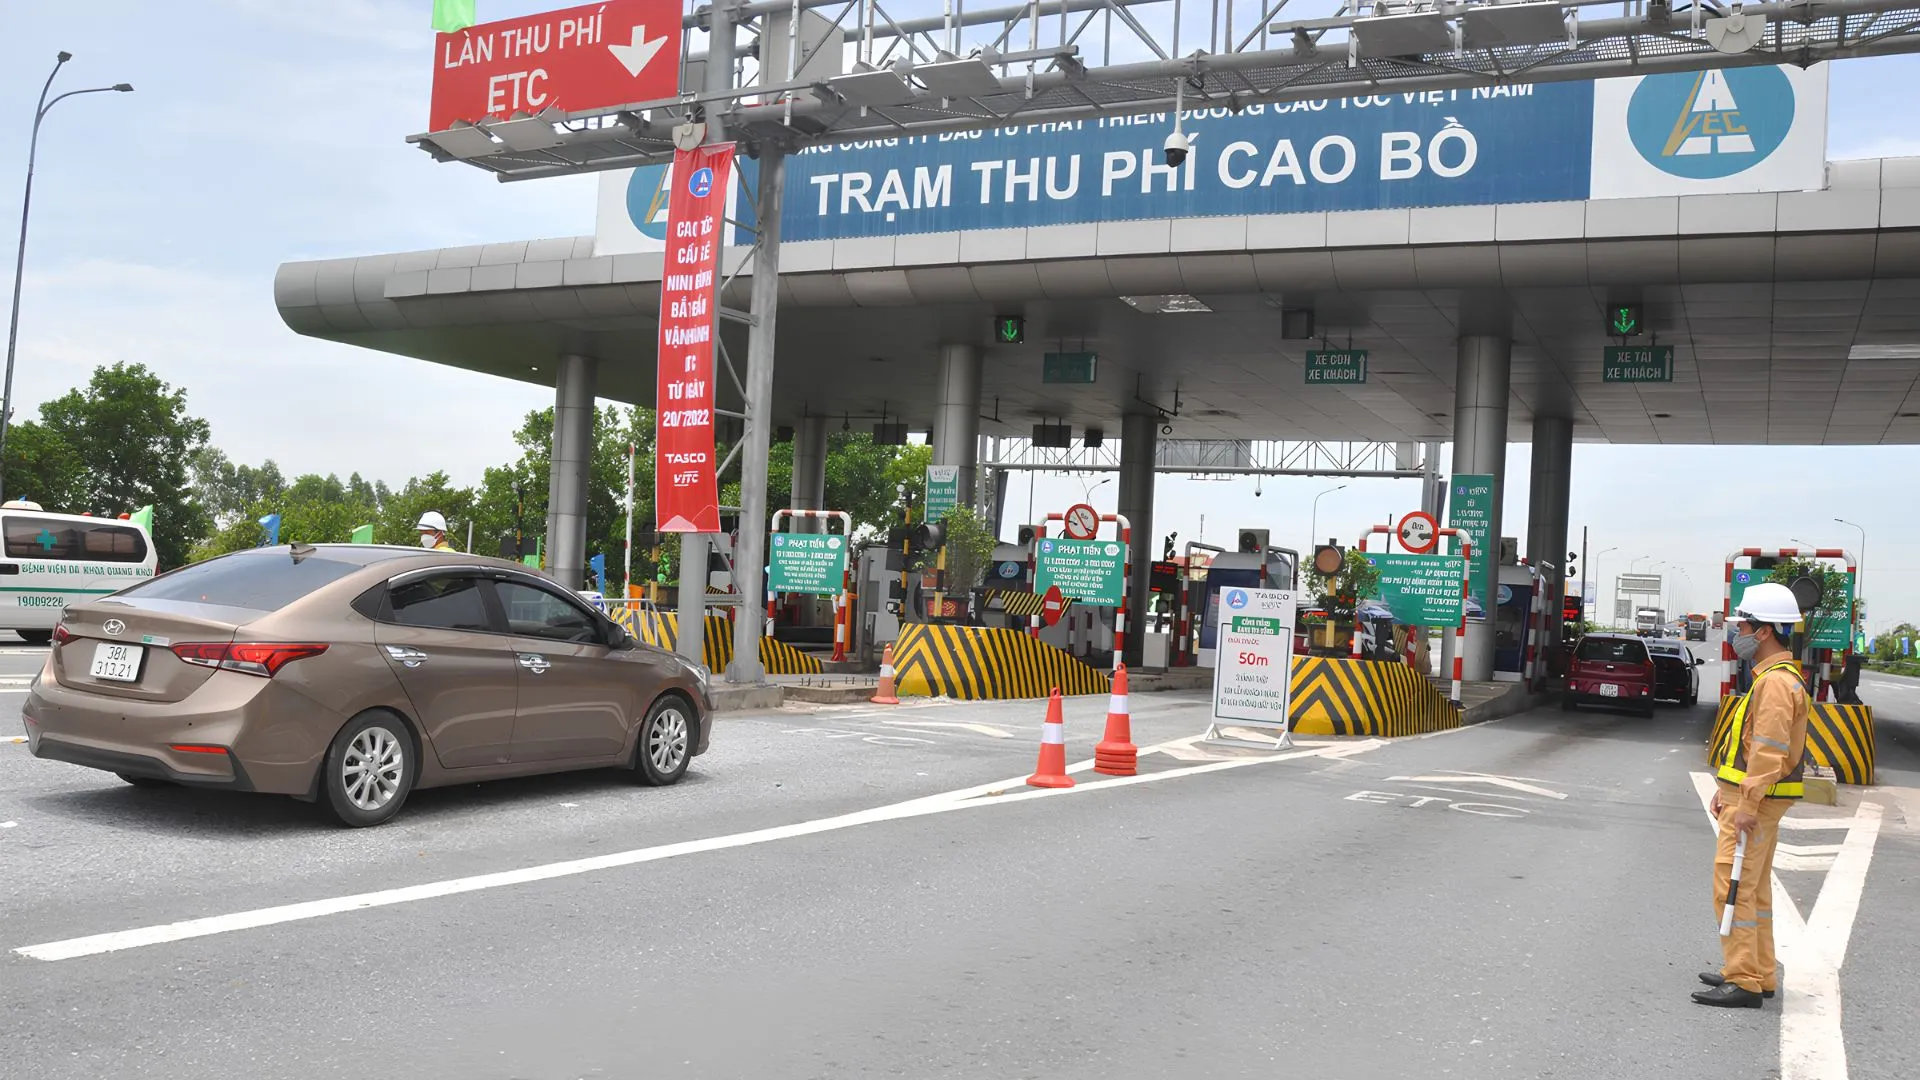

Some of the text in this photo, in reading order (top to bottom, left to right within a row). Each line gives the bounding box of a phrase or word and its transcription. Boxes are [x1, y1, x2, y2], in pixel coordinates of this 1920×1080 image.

[445, 5, 606, 69] LÀN THU PHÍ
[487, 68, 548, 112] ETC
[810, 116, 1478, 222] TRẠM THU PHÍ CAO BỒ
[665, 453, 706, 464] TASCO
[107, 646, 128, 661] 38A
[1238, 652, 1269, 667] 50m
[95, 661, 132, 678] 313.21
[1344, 790, 1531, 817] ETC
